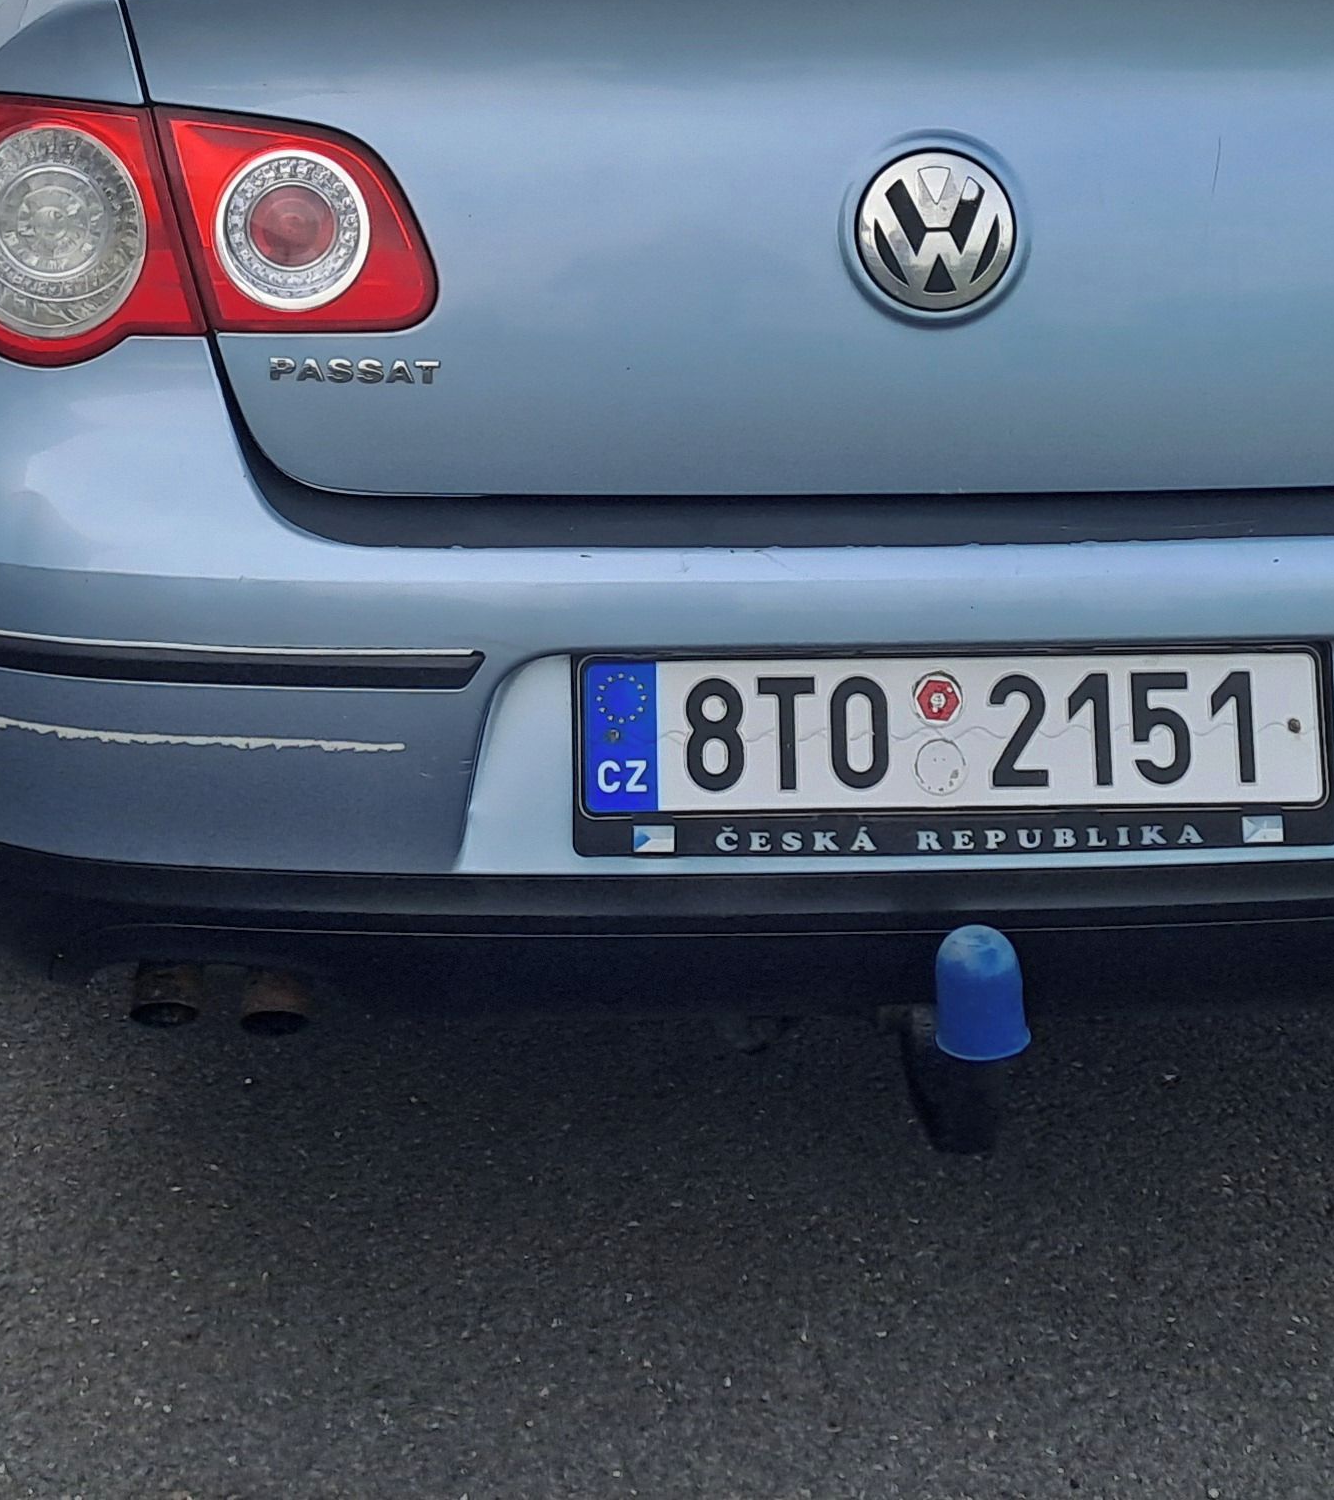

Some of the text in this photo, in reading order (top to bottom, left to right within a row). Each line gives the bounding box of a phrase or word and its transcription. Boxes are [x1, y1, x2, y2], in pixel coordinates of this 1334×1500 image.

[269, 357, 441, 384] PASSAT
[988, 670, 1259, 789] 2151
[596, 759, 649, 794] CZ
[714, 822, 1206, 854] ČESKÁ REPUBLIKA
